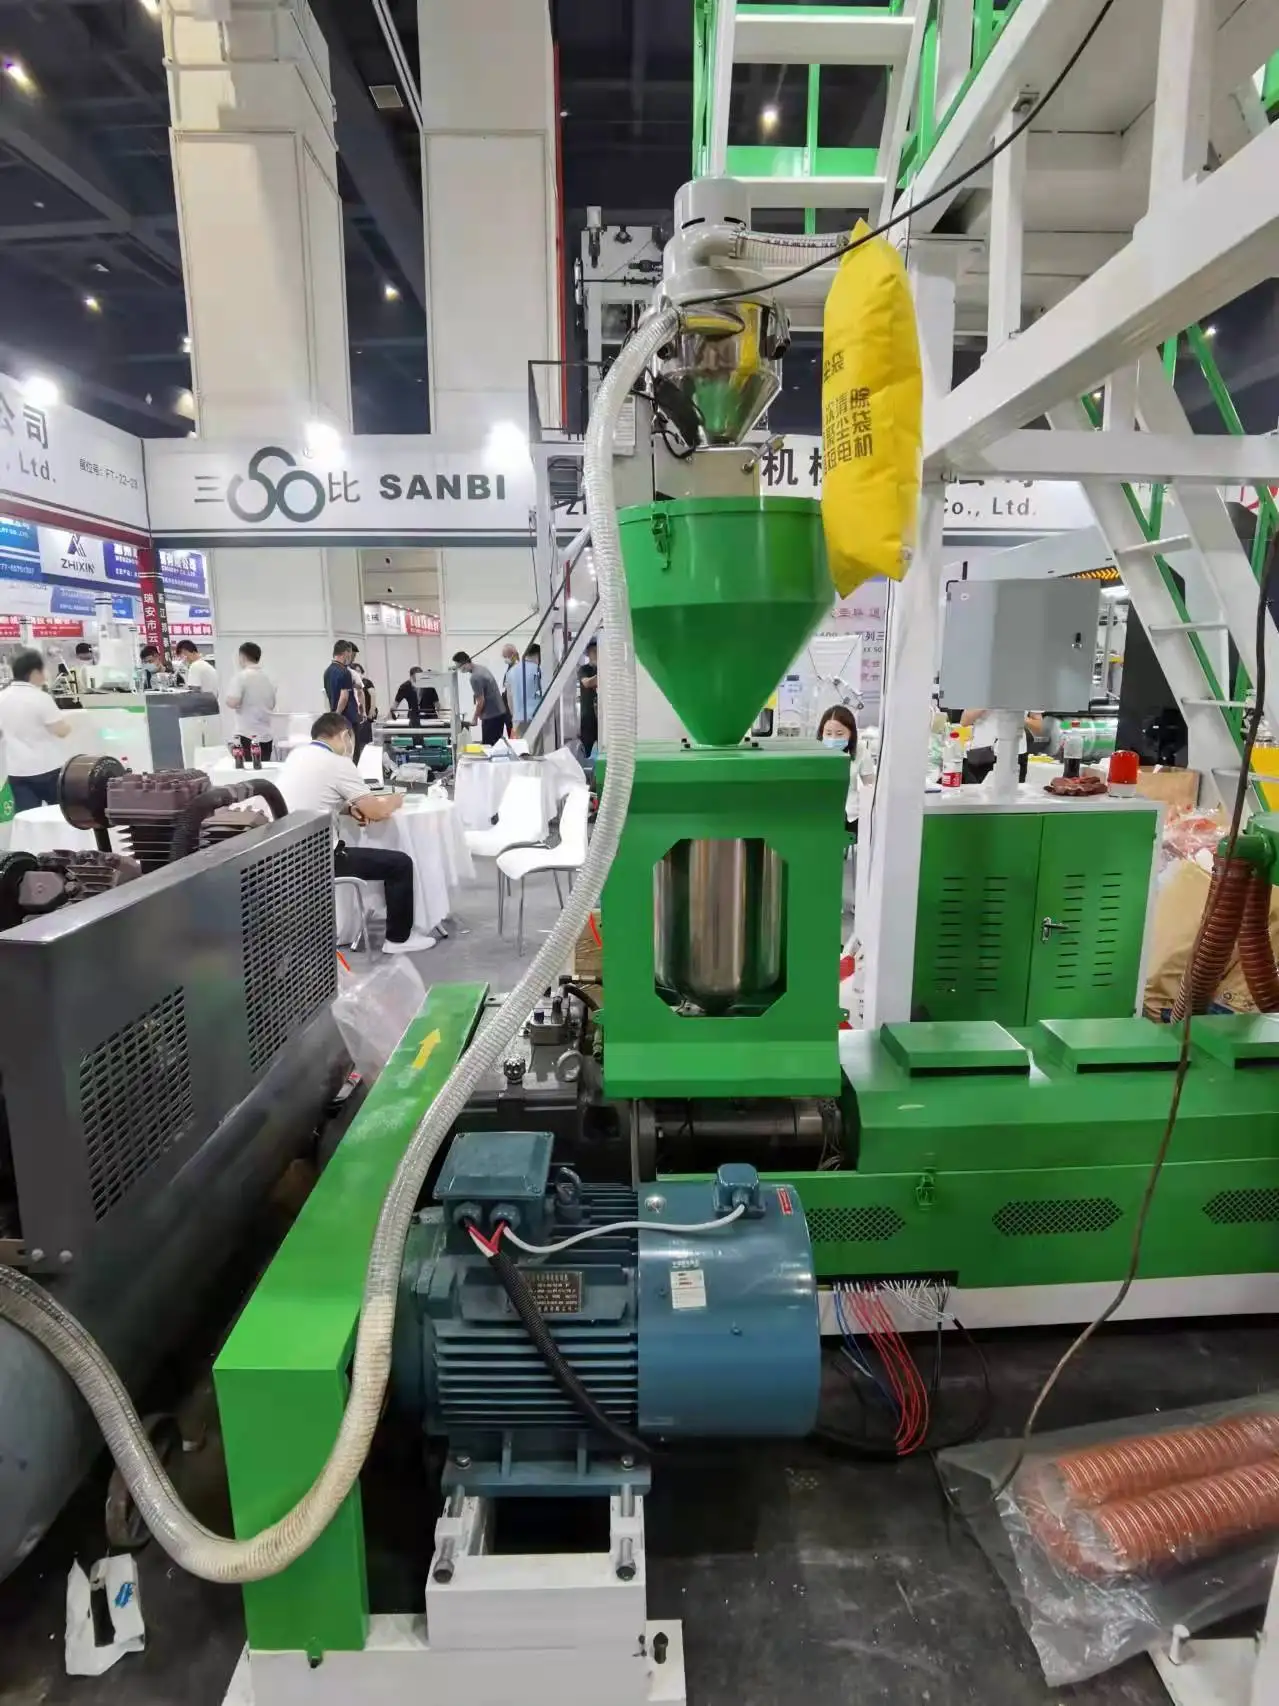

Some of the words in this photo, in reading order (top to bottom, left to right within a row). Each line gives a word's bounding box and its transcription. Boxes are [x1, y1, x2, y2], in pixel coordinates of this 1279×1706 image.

[18, 449, 57, 483] Ltd.
[379, 474, 506, 500] SANBI
[943, 497, 980, 517] o.,
[992, 497, 1036, 516] Ltd.
[60, 558, 95, 574] ZHIXIN
[143, 592, 160, 654] 瑞安市云
